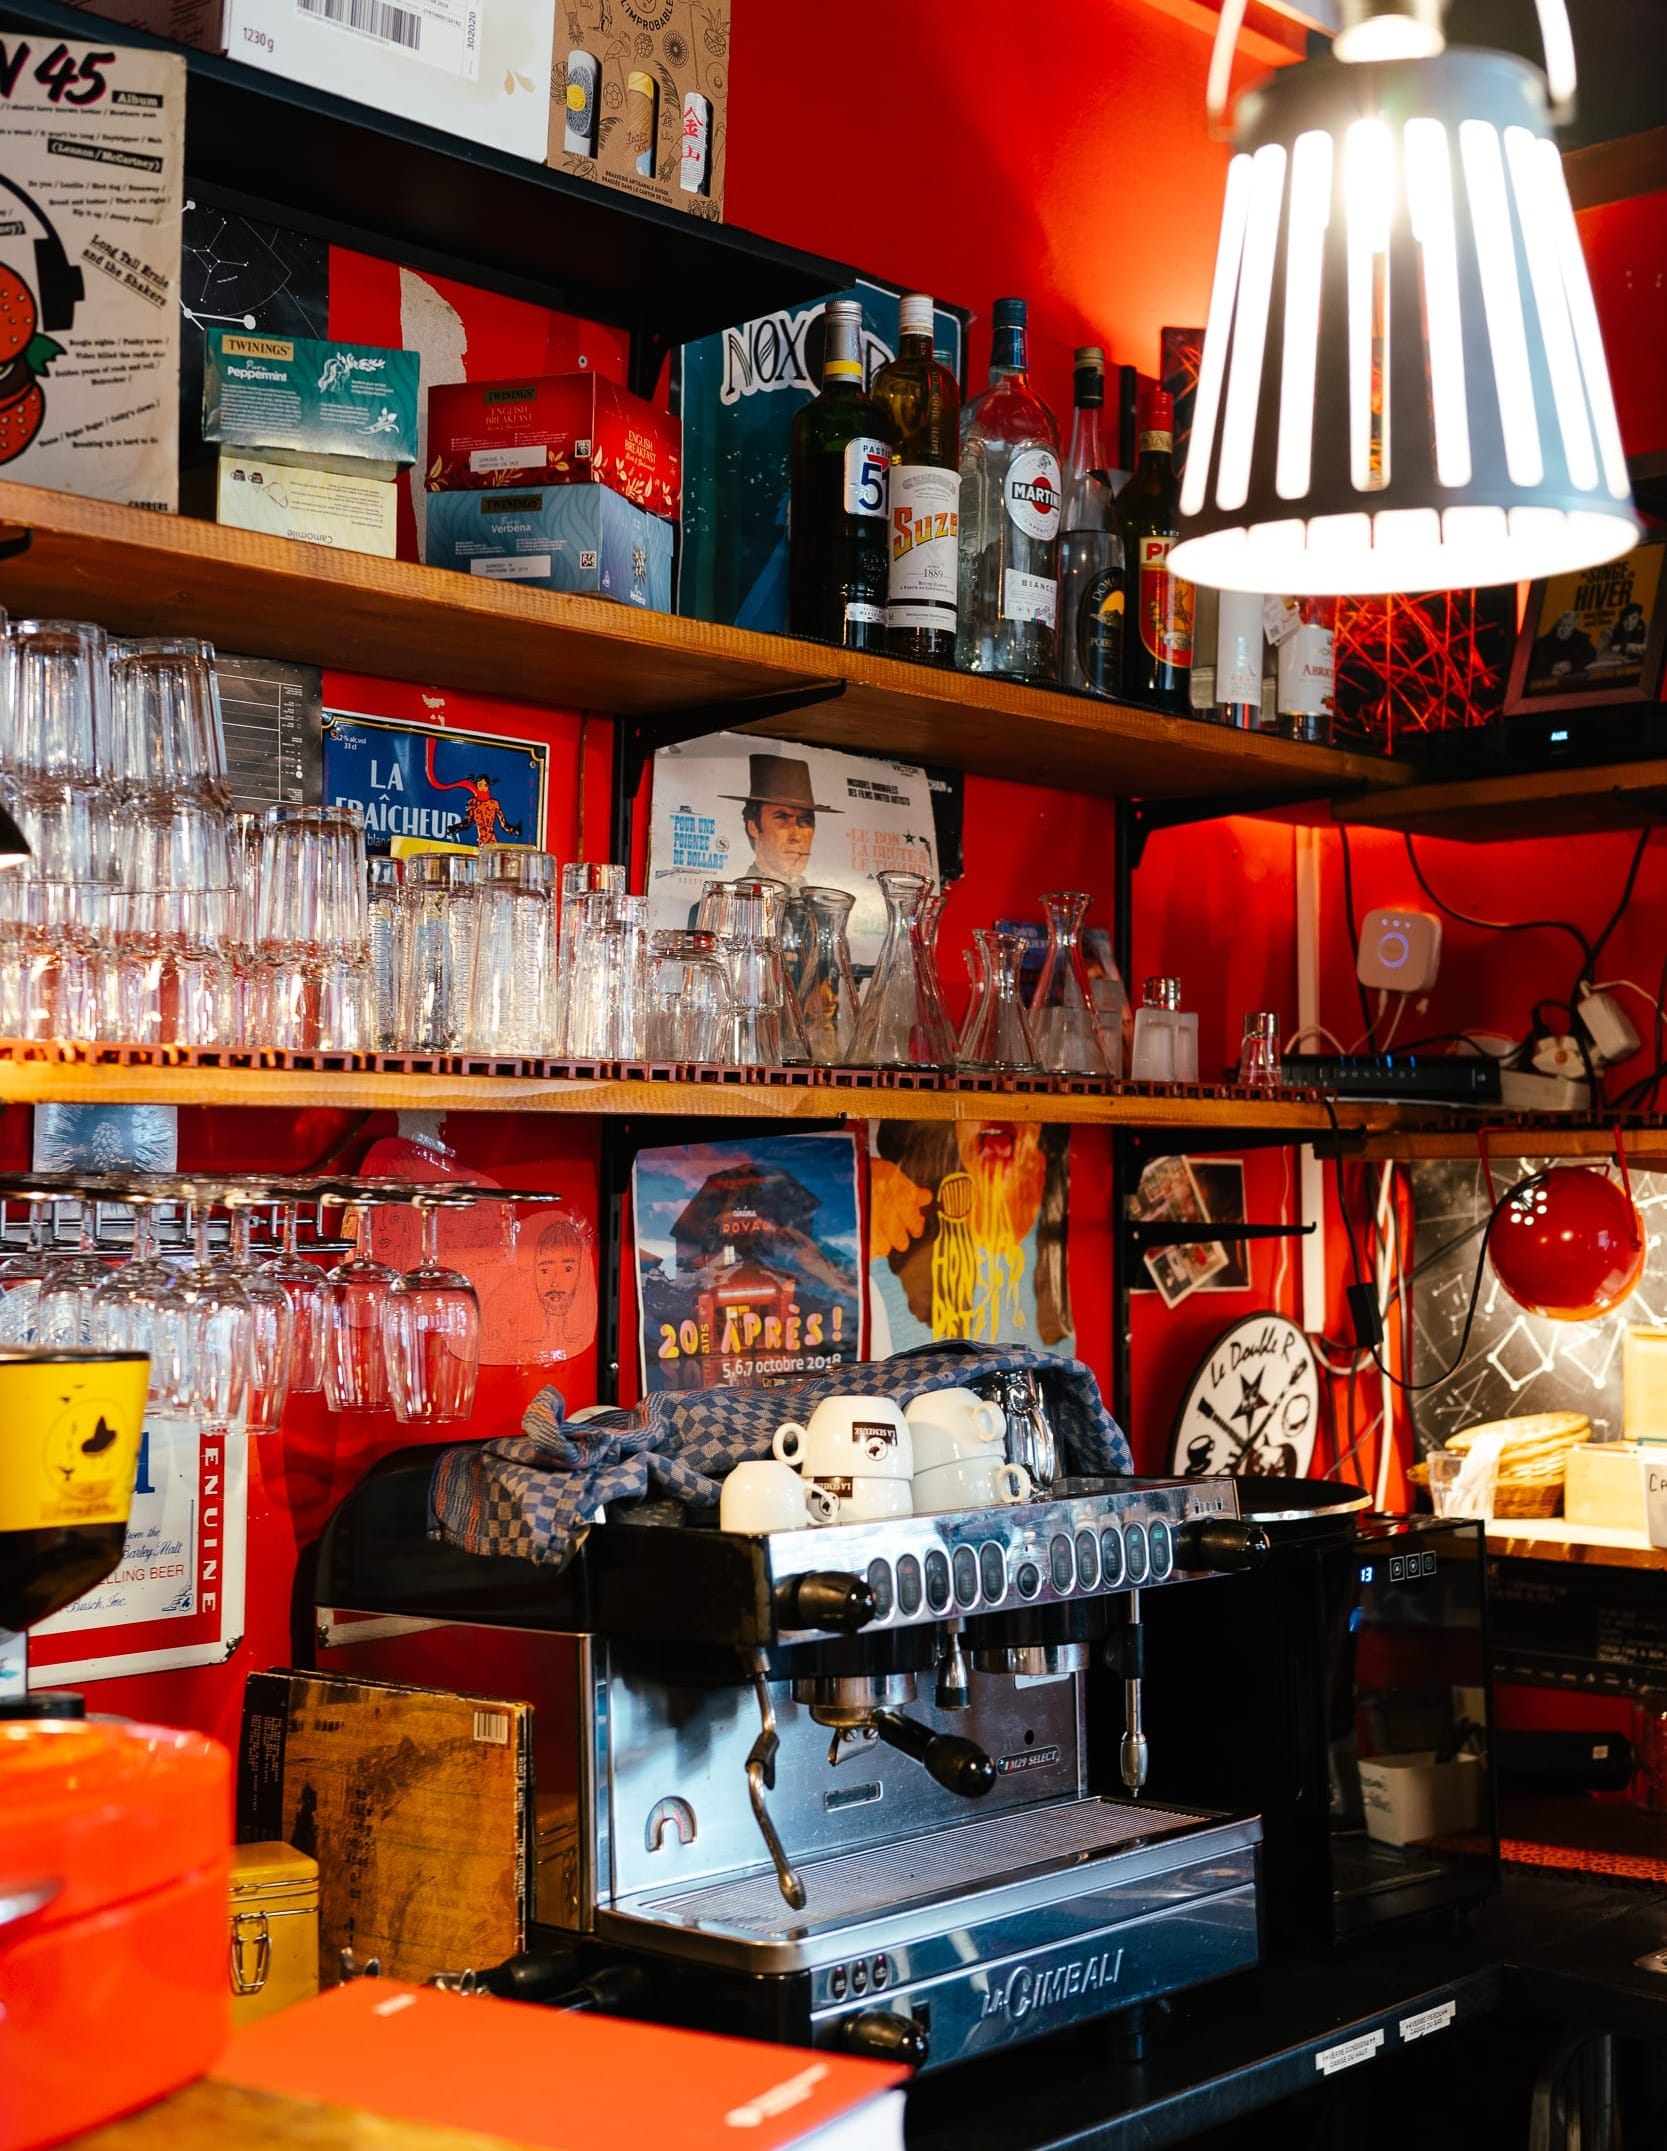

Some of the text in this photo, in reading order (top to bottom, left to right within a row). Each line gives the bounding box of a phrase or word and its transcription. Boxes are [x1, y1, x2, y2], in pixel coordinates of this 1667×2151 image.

[243, 27, 275, 52] 1230 g
[466, 11, 477, 50] 302020
[34, 43, 116, 106] 45
[117, 93, 159, 107] Album
[90, 234, 170, 289] Long Tall Ernie
[82, 248, 168, 307] and the Shakers
[228, 339, 290, 356] TWININGS
[227, 365, 288, 382] Peppermint
[485, 413, 532, 425] BREAKFAST
[491, 405, 528, 416] ENGLISH
[627, 429, 653, 451] ENGLISH
[624, 439, 657, 464] BREAKFAST
[287, 529, 334, 544] Camomile
[491, 523, 531, 533] Verbena
[923, 568, 944, 579] 1889
[1574, 580, 1633, 611] HIVER
[370, 759, 404, 791] LA
[698, 817, 716, 835] UNE
[673, 831, 710, 851] POIGNEE
[874, 831, 900, 845] BON
[673, 849, 685, 866] DE
[658, 1319, 699, 1359] 20
[700, 1323, 711, 1354] ans
[720, 1303, 823, 1354] APRÈS
[755, 1355, 804, 1375] octobre
[807, 1353, 842, 1370] 2018
[1211, 1326, 1296, 1389] Le Double R
[148, 1526, 161, 1538] the
[202, 1446, 219, 1614] ENUINE
[123, 1540, 182, 1562] Barley Malt
[150, 1564, 185, 1580] BEER
[1361, 1566, 1374, 1582] 13
[1028, 1750, 1058, 1765] SELECT
[1004, 1948, 1124, 2022] CIMBALI
